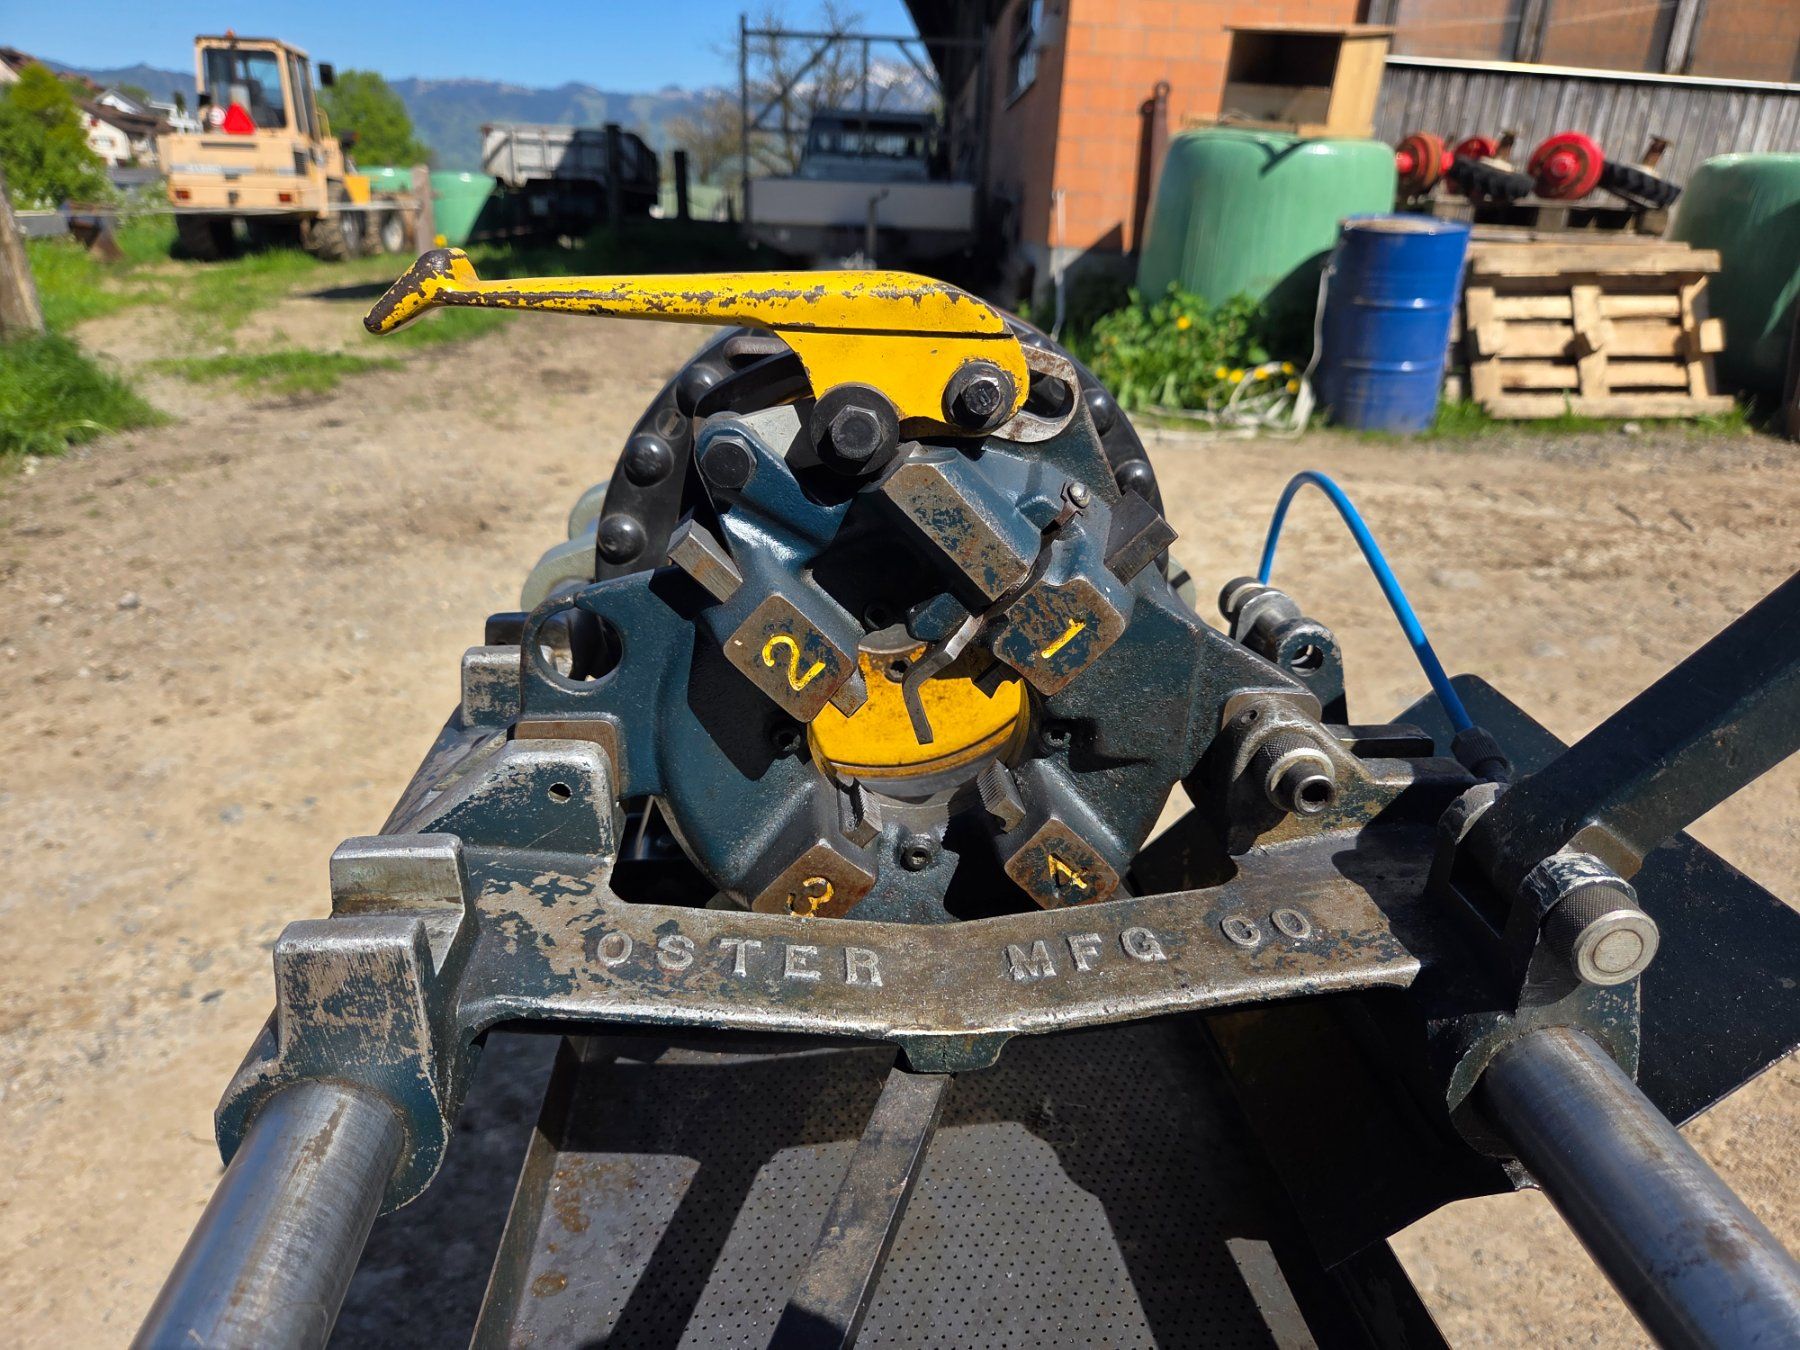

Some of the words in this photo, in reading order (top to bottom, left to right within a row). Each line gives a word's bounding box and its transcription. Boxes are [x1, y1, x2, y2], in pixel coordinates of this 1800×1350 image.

[1041, 617, 1086, 659] 1
[761, 635, 827, 691] 2
[785, 876, 834, 918] 3
[598, 930, 884, 988] OSTER
[1004, 926, 1168, 982] MFG
